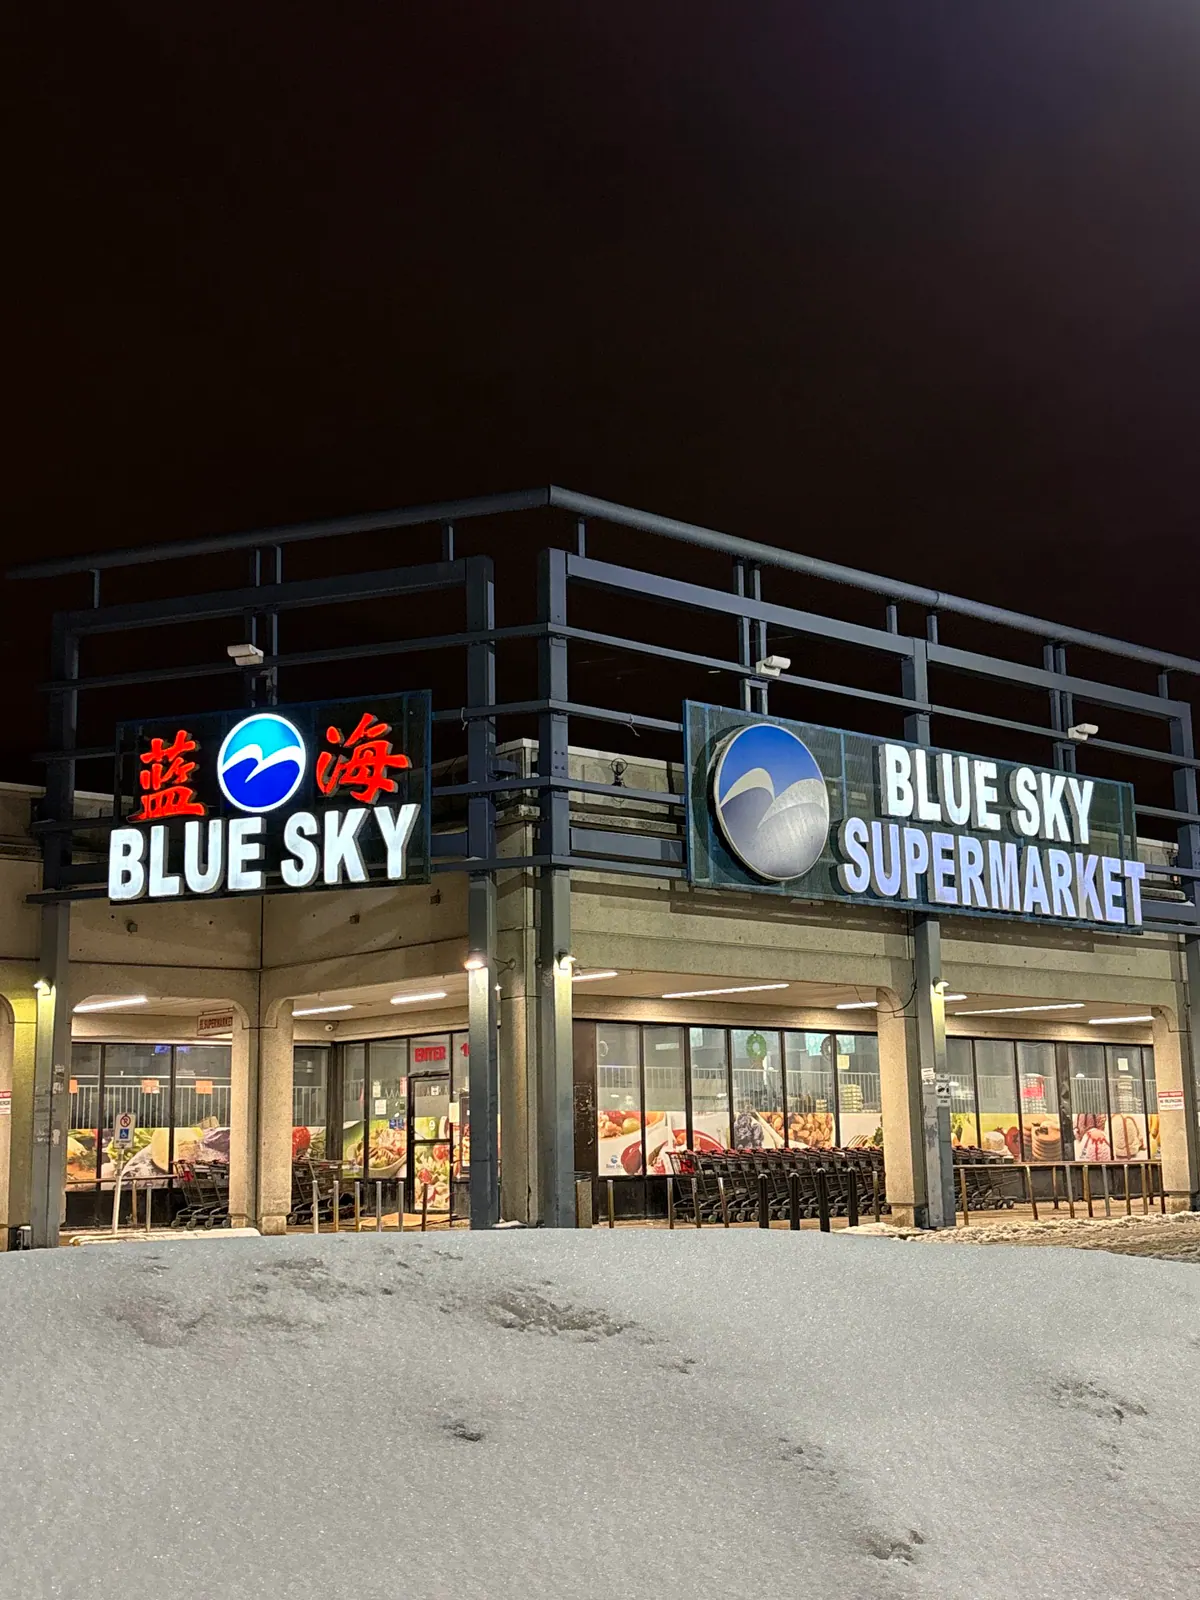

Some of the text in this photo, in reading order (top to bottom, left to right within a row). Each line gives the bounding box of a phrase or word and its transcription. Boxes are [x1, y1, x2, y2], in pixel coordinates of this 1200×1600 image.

[316, 712, 412, 804] 海
[879, 743, 1094, 845] BLUE SKY
[108, 803, 421, 901] BLUE SKY
[838, 816, 1146, 927] SUPERMARKET
[414, 1046, 446, 1062] ENTER
